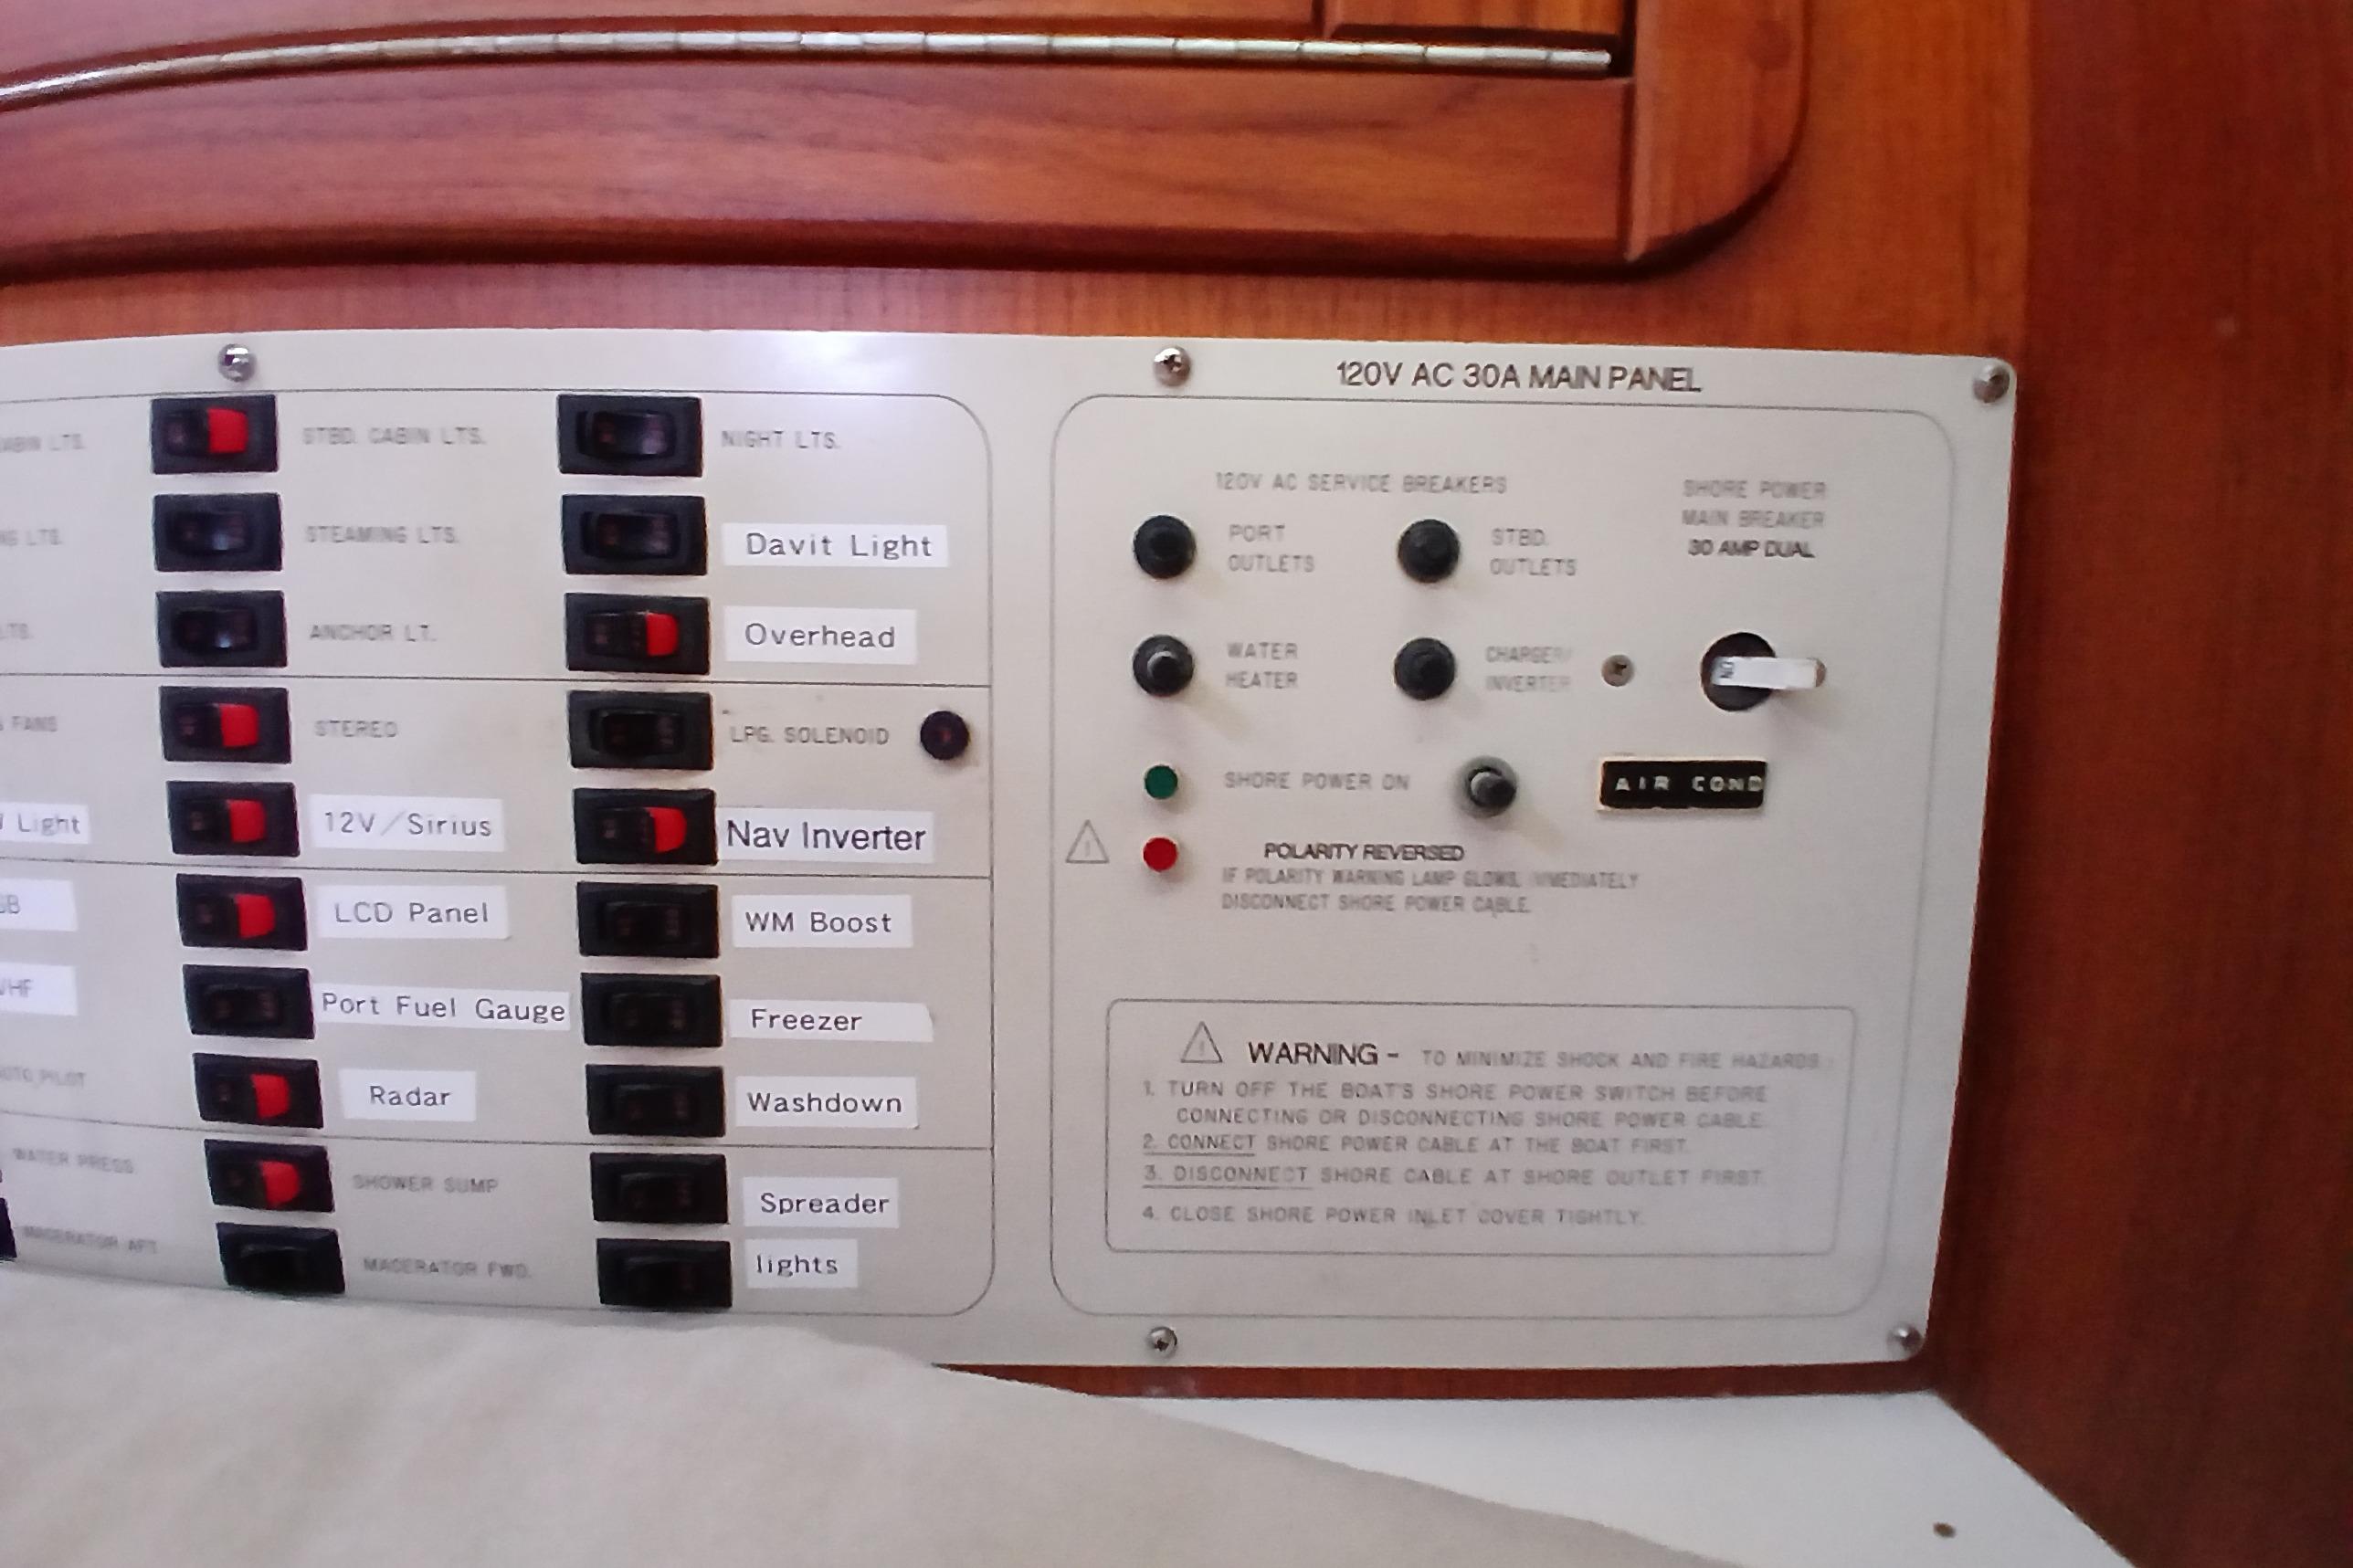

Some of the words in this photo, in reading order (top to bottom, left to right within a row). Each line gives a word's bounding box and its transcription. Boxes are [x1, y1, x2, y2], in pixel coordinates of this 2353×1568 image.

[1336, 362, 1403, 387] 120V
[1412, 363, 1454, 388] AC
[1463, 363, 1520, 389] 30A
[1529, 365, 1600, 391] MAIN
[1609, 367, 1704, 393] PANEL
[368, 427, 430, 445] CABIN
[722, 431, 783, 447] NIGHT
[1217, 472, 1263, 489] 120V
[1272, 474, 1297, 490] AC
[1308, 474, 1391, 493] SERVICE
[1403, 476, 1508, 494] BREAKERS
[1683, 479, 1747, 498] SHORE
[1760, 481, 1826, 500] POWER
[1683, 510, 1728, 526] MAIN
[1738, 510, 1825, 529] BREAKER
[1229, 524, 1285, 542] PORT
[746, 533, 832, 557] Davit
[851, 534, 932, 560] Light
[1688, 539, 1714, 555] 30
[1718, 540, 1759, 556] AMP
[1765, 541, 1815, 558] DUAL
[1228, 554, 1314, 573] OUTLETS
[1489, 558, 1577, 576] OUTLETS
[310, 624, 393, 640] ANCHOR
[744, 623, 896, 648] Overhead
[1227, 642, 1298, 659] WATER
[1225, 672, 1298, 689] HEATER
[315, 721, 398, 737] STEREO
[785, 727, 889, 745] SOLENOID
[1224, 772, 1291, 789] SHORE
[1303, 773, 1371, 790] POWER
[1381, 773, 1410, 791] ON
[1614, 776, 1670, 792] AIR
[1692, 775, 1764, 792] COND
[325, 810, 491, 837] 12V/Sirius
[727, 819, 788, 848] Nav
[803, 822, 926, 852] Inverter
[1264, 842, 1358, 859] POLARITY
[1362, 844, 1465, 861] REVERSED
[1245, 868, 1324, 884] POLARITY
[1412, 869, 1456, 887] LAMP
[1221, 893, 1330, 910] DISCONNECT
[1338, 894, 1397, 911] SHORE
[1404, 895, 1463, 912] POWER
[335, 902, 394, 923] LCD
[408, 903, 490, 924] Panel
[745, 912, 794, 932] WM
[810, 912, 892, 933] Boost
[322, 992, 380, 1016] Port
[396, 995, 457, 1018] Fuel
[475, 998, 565, 1028] Gauge
[751, 1009, 863, 1032] Freezer
[1248, 1042, 1378, 1066] WARNING
[1422, 1049, 1446, 1067] TO
[1556, 1052, 1620, 1068] SHOCK
[1630, 1052, 1668, 1068] AND
[1678, 1053, 1722, 1069] FIRE
[369, 1086, 452, 1108] Radar
[1168, 1080, 1224, 1098] TURN
[1235, 1081, 1275, 1099] OFF
[1290, 1081, 1328, 1099] THE
[1425, 1083, 1497, 1101] SHORE
[1508, 1084, 1583, 1101] POWER
[1594, 1085, 1675, 1102] SWITCH
[1685, 1086, 1769, 1103] BEFORE
[747, 1092, 903, 1113] Washdown
[1176, 1108, 1308, 1126] CONNECTING
[1318, 1110, 1346, 1126] OR
[1358, 1109, 1524, 1128] DISCONNECTING
[1535, 1110, 1601, 1128] SHORE
[1615, 1111, 1685, 1129] POWER
[1167, 1133, 1255, 1150] CONNECT
[1266, 1134, 1330, 1152] SHORE
[1341, 1135, 1408, 1152] POWER
[1418, 1136, 1478, 1153] CABLE
[1489, 1137, 1513, 1152] AT
[1525, 1137, 1560, 1153] THE
[1571, 1137, 1620, 1153] BOAT
[353, 1173, 434, 1192] SHOWER
[444, 1176, 499, 1193] SUMP
[1174, 1165, 1308, 1183] DISCONNECT
[1320, 1166, 1391, 1184] SHORE
[1404, 1168, 1472, 1184] CABLE
[1483, 1168, 1511, 1184] AT
[1523, 1168, 1594, 1185] SHORE
[1606, 1169, 1691, 1185] OUTLET
[760, 1192, 890, 1216] Spreader
[1170, 1205, 1235, 1223] CLOSE
[1247, 1206, 1314, 1224] SHORE
[1326, 1207, 1396, 1224] POWER
[1409, 1208, 1464, 1225] INLET
[1477, 1208, 1545, 1226] COVER
[757, 1256, 839, 1282] lights
